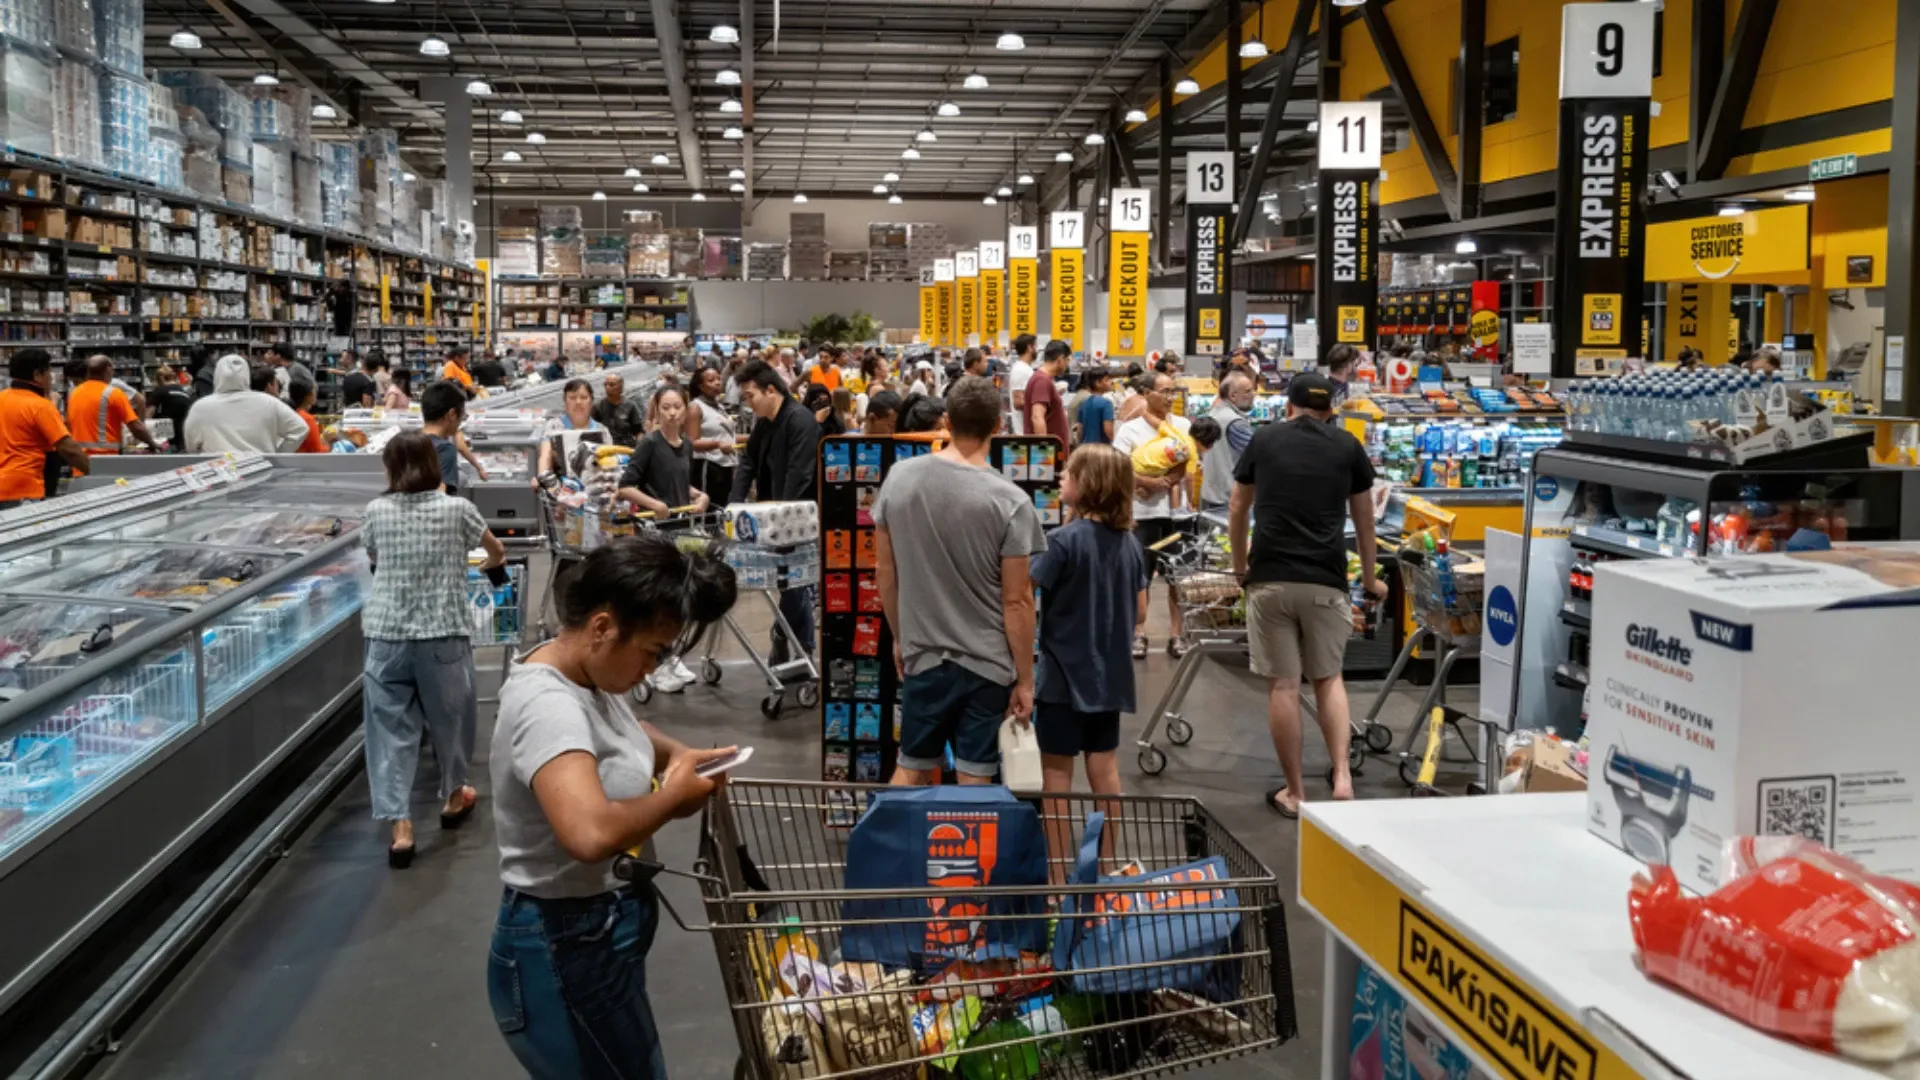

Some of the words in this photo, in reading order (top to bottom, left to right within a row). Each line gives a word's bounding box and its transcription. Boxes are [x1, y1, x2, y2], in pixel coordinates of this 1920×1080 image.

[1595, 23, 1625, 77] 9
[1337, 116, 1367, 153] 11
[1197, 162, 1225, 193] 13
[1579, 114, 1617, 258] EXPRESS
[1058, 219, 1077, 241] 17
[1120, 197, 1143, 222] 15
[1334, 180, 1357, 282] EXPRESS
[1691, 222, 1744, 241] CUSTOMER
[1016, 233, 1033, 251] 19
[1196, 216, 1216, 295] EXPRESS
[1691, 238, 1744, 260] SERVICE
[962, 281, 972, 335] CHECKOUT
[986, 275, 998, 335] CHECKOUT
[1016, 264, 1031, 331] CHECKOUT
[1060, 255, 1075, 334] CHECKOUT
[1119, 240, 1140, 332] CHECKOUT
[1680, 283, 1698, 338] EXIT
[1490, 606, 1514, 625] NIVEA
[1700, 619, 1735, 643] NEW
[1624, 649, 1694, 683] SKINGUARD
[1625, 622, 1692, 666] Gillette
[1603, 692, 1623, 711] FOR
[1625, 702, 1682, 737] SENSITIVE
[1685, 727, 1716, 752] SKIN
[1605, 676, 1661, 709] CLINICALLY
[1663, 698, 1714, 731] PROVEN
